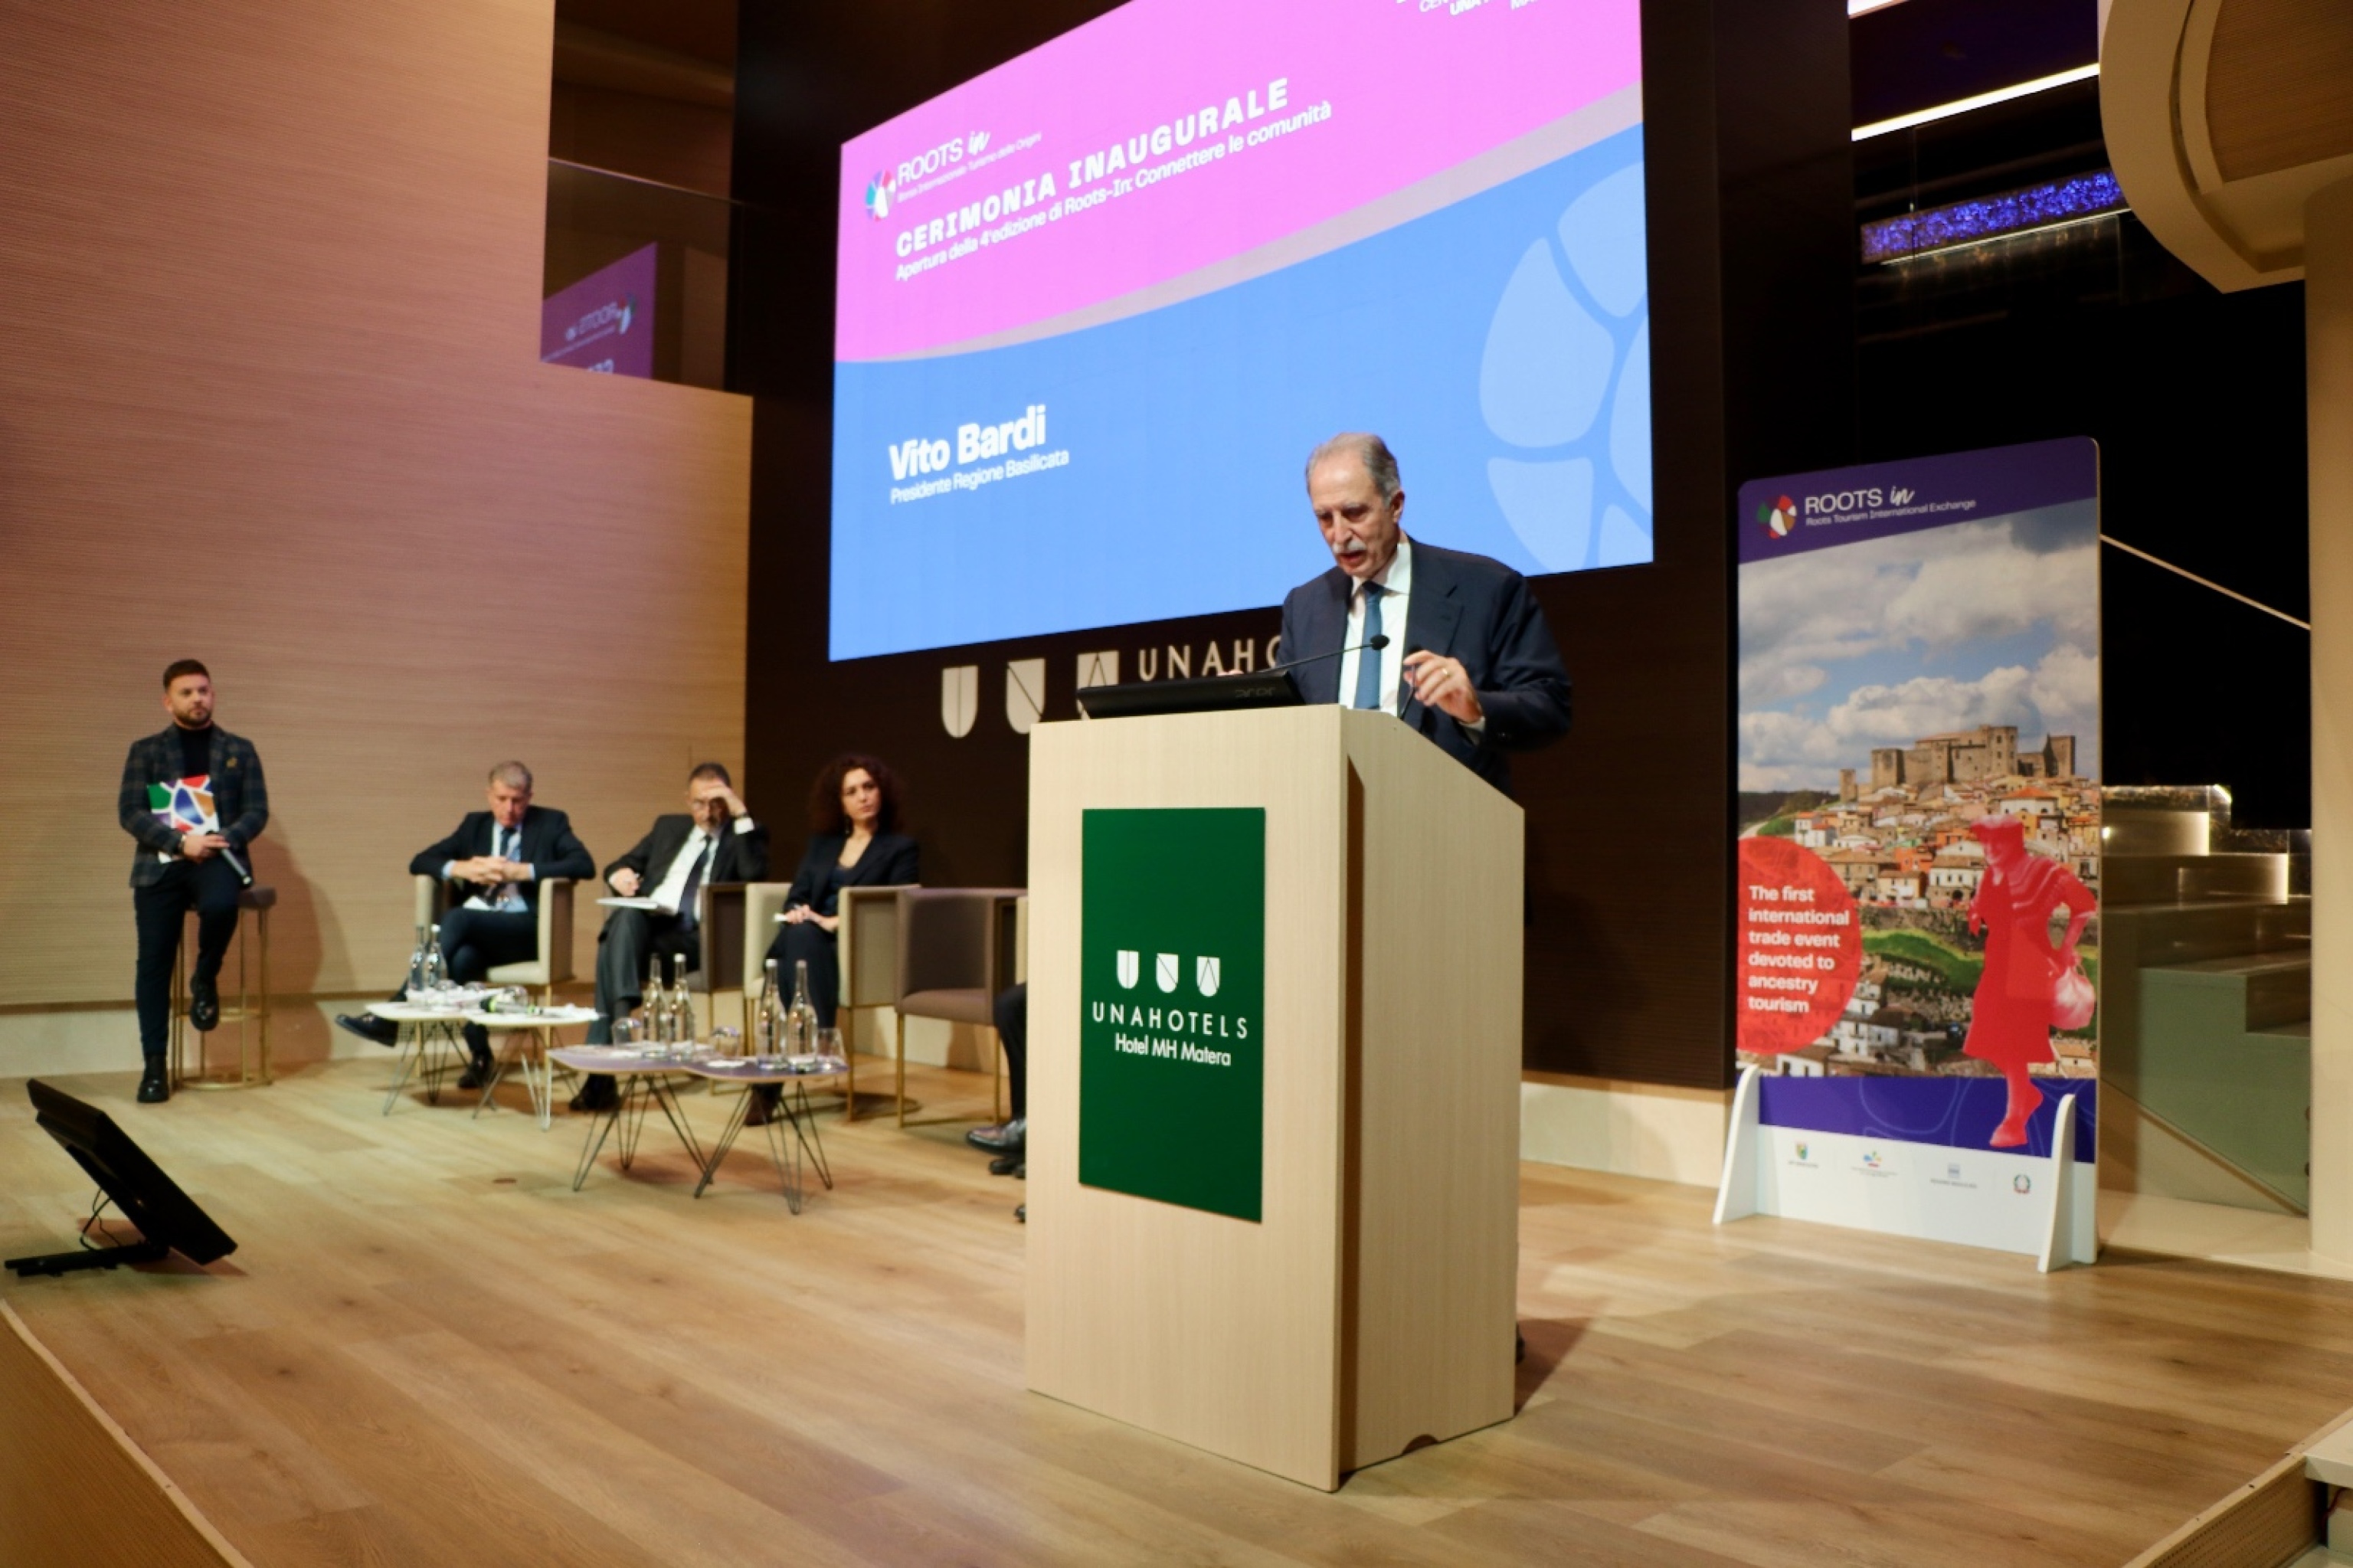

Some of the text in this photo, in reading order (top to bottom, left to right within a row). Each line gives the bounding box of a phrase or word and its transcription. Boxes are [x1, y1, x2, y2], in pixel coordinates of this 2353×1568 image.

[896, 77, 1288, 258] CERIMONIA INAUGURALE
[898, 137, 964, 186] ROOTS
[895, 250, 947, 281] Apertura
[948, 237, 979, 260] della
[1049, 201, 1062, 221] di
[1135, 143, 1226, 188] Connettere
[1228, 134, 1245, 153] le
[1247, 100, 1331, 146] comunità
[889, 404, 1046, 480] Vito Bardi
[890, 450, 1070, 506] Presidente Regione Basilicata
[1805, 488, 1883, 516] ROOTS
[1805, 499, 1977, 526] Roots Tourism International Exchange
[1749, 885, 1815, 902] The first
[1748, 908, 1850, 926] international
[1749, 930, 1841, 948] trade event
[1748, 951, 1835, 970] devoted to
[1748, 975, 1818, 995] ancestry
[1747, 996, 1809, 1013] tourism
[1092, 1001, 1248, 1039] UNAHOTELS
[1115, 1032, 1232, 1067] Hotel MH Matera
